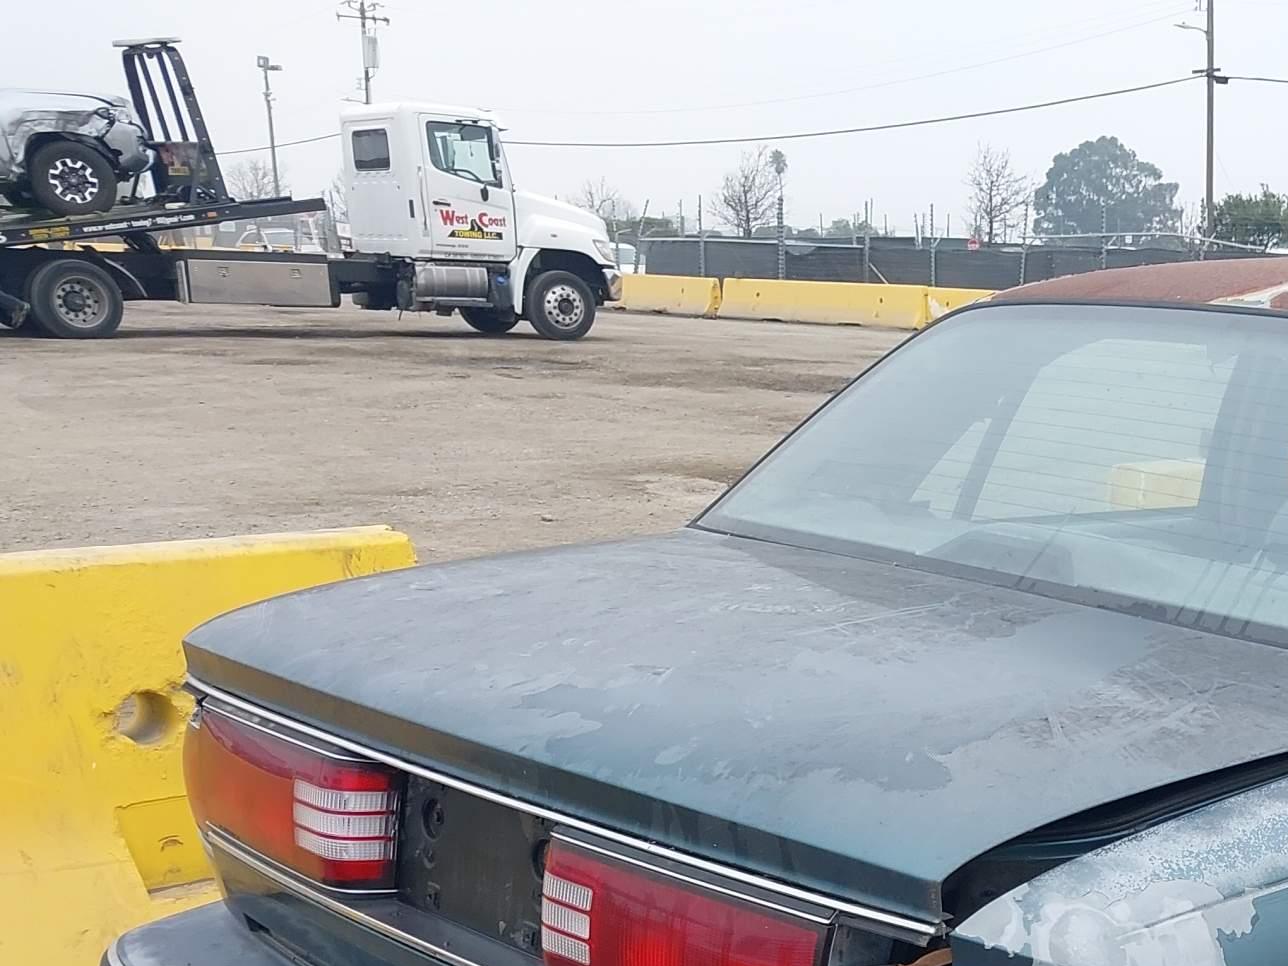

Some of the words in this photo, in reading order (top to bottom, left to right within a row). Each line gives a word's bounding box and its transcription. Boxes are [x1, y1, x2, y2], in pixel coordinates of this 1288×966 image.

[440, 208, 469, 226] West
[478, 212, 506, 229] Coast
[454, 230, 482, 239] TOWING
